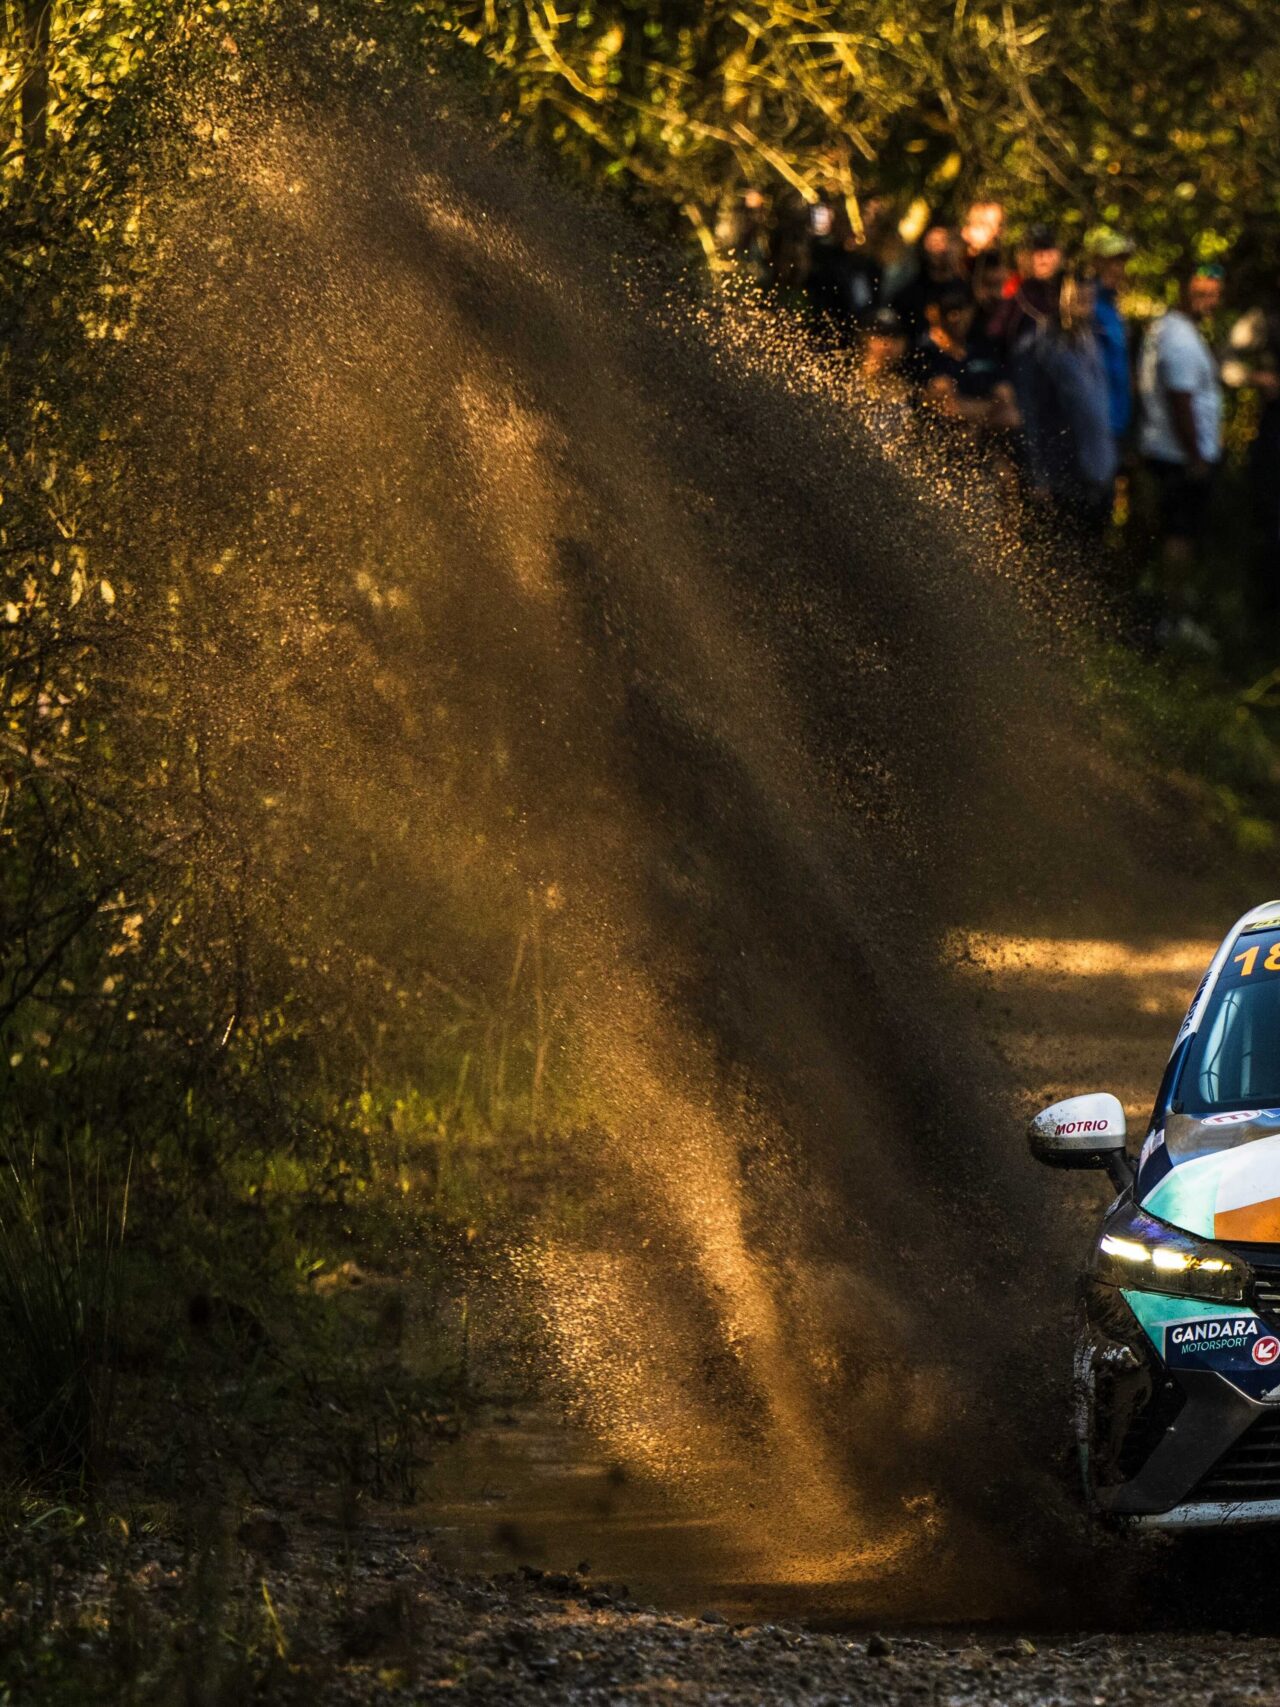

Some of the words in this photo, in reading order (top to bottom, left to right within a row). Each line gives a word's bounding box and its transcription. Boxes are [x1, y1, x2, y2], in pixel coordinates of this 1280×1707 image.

[1055, 1119, 1108, 1136] MOTRIO
[1172, 1320, 1259, 1344] GANDARA
[1181, 1336, 1248, 1355] MOTORSPORT
